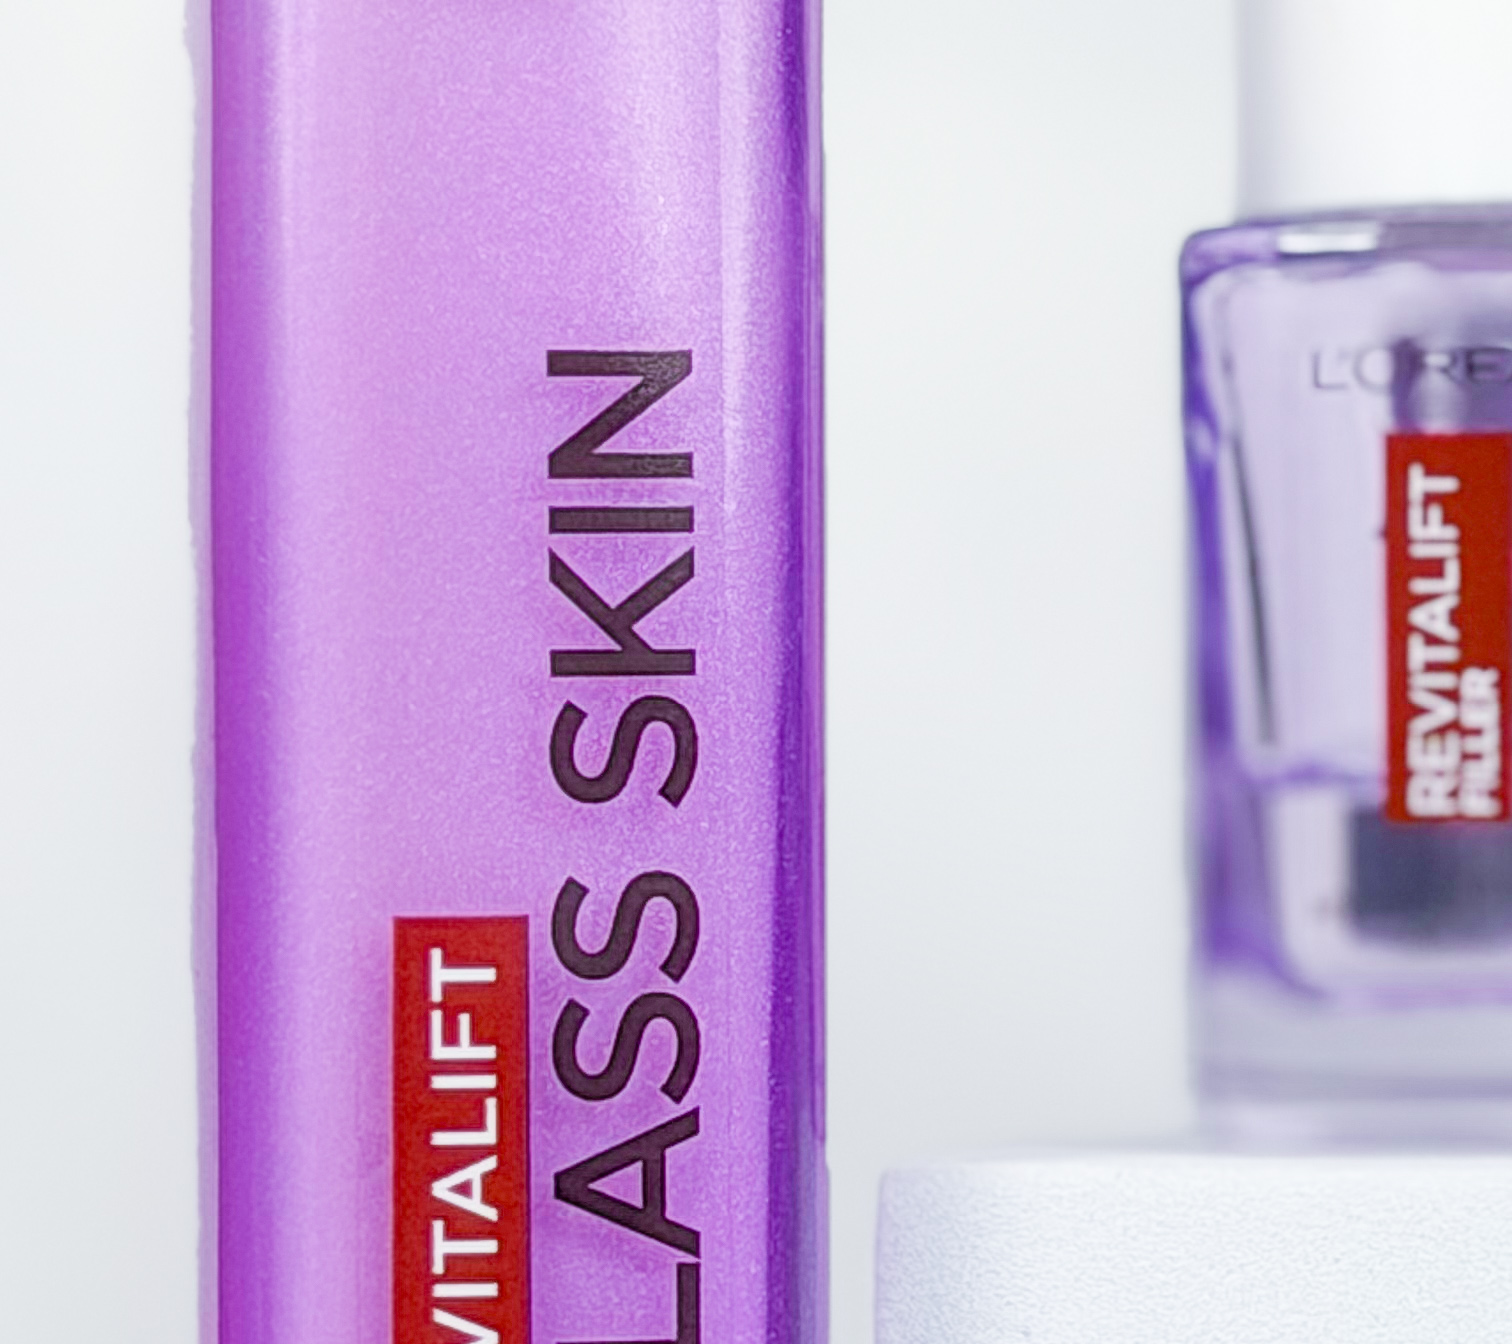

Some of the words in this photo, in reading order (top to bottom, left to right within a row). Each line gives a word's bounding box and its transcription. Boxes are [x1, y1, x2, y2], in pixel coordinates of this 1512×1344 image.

[546, 349, 699, 809] SKIN
[1406, 461, 1461, 818] REVITALIFT
[1459, 666, 1500, 819] FILLER
